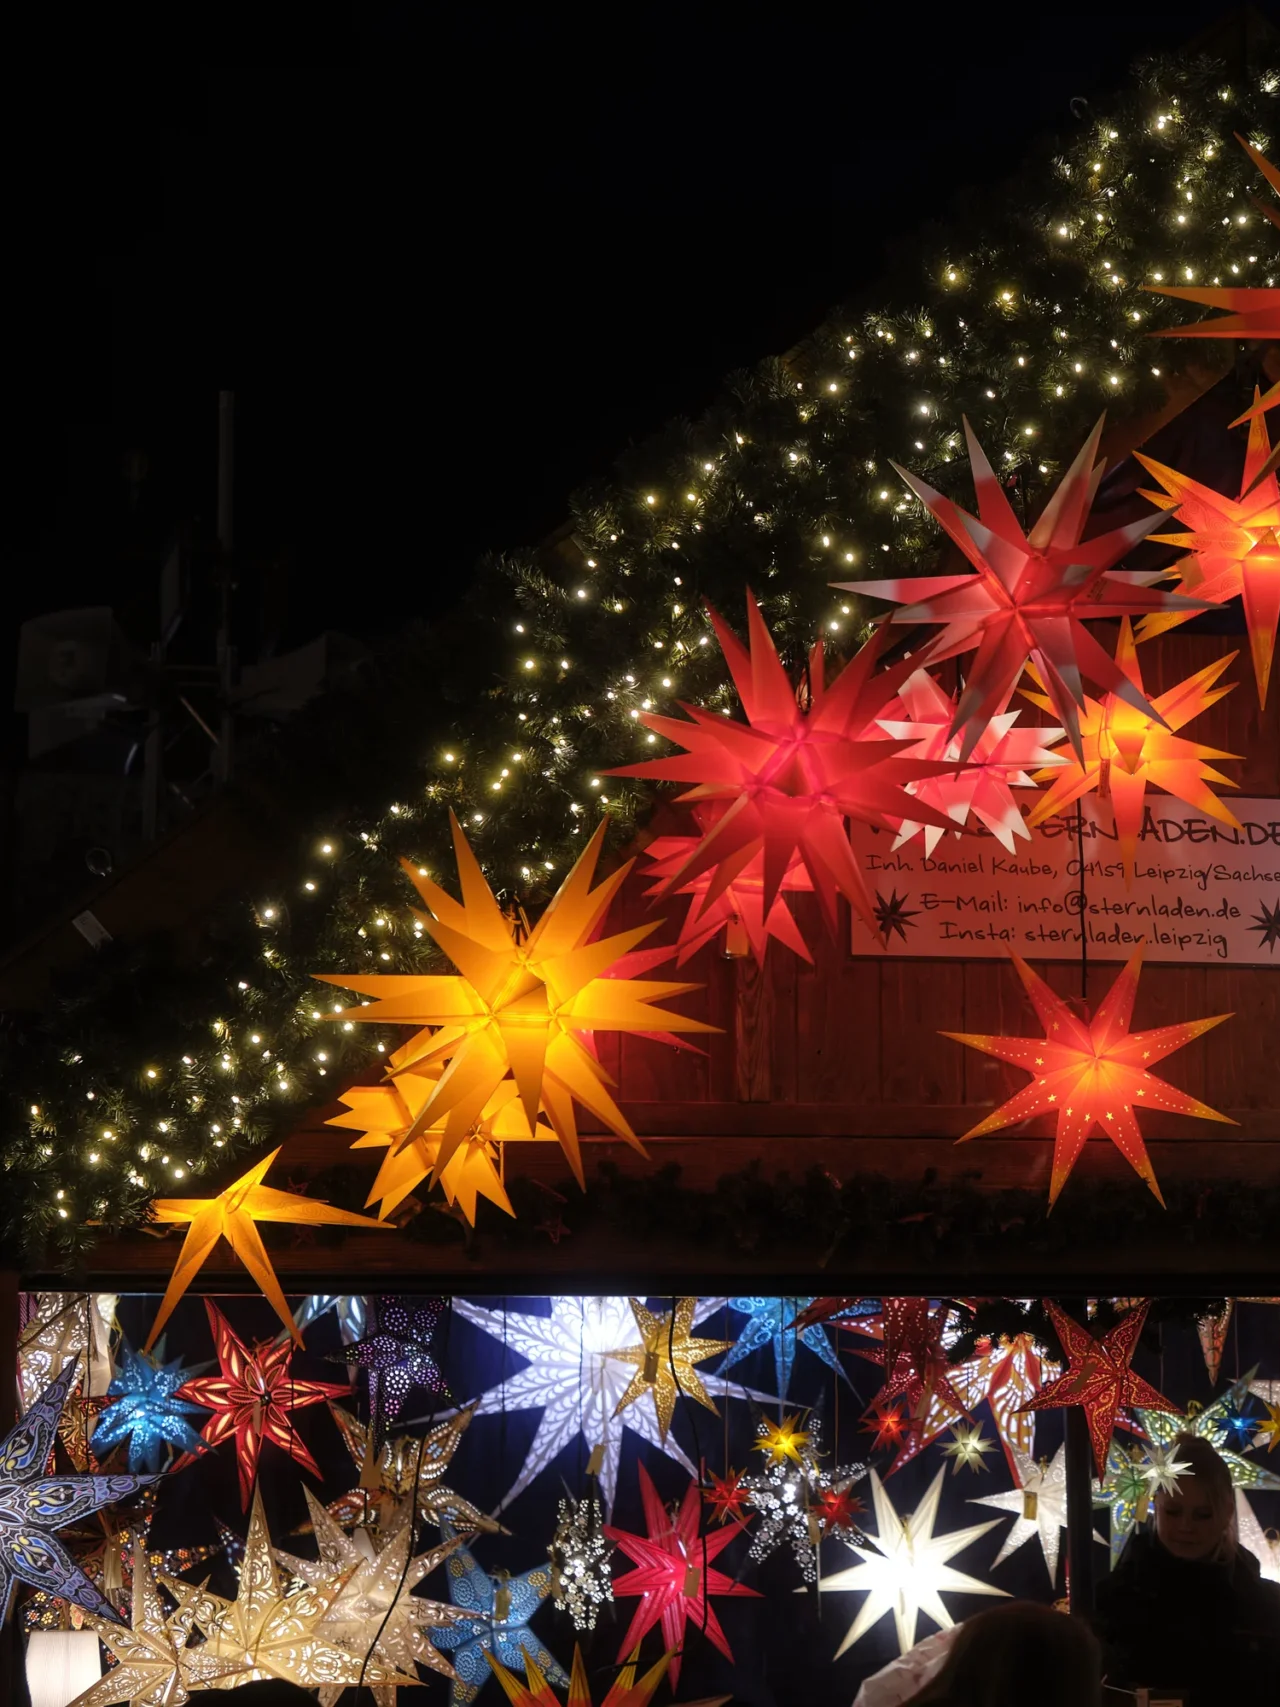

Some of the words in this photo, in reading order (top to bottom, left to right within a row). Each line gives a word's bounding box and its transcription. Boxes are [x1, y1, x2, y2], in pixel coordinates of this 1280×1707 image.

[866, 854, 914, 872] Inh.
[920, 854, 985, 874] Daniel
[992, 857, 1058, 879] Kaube,
[1066, 859, 1125, 878] 04159
[920, 890, 1008, 914] E-Mail:
[1018, 890, 1241, 919] info@sternladen.de
[939, 921, 1016, 942] Insta:
